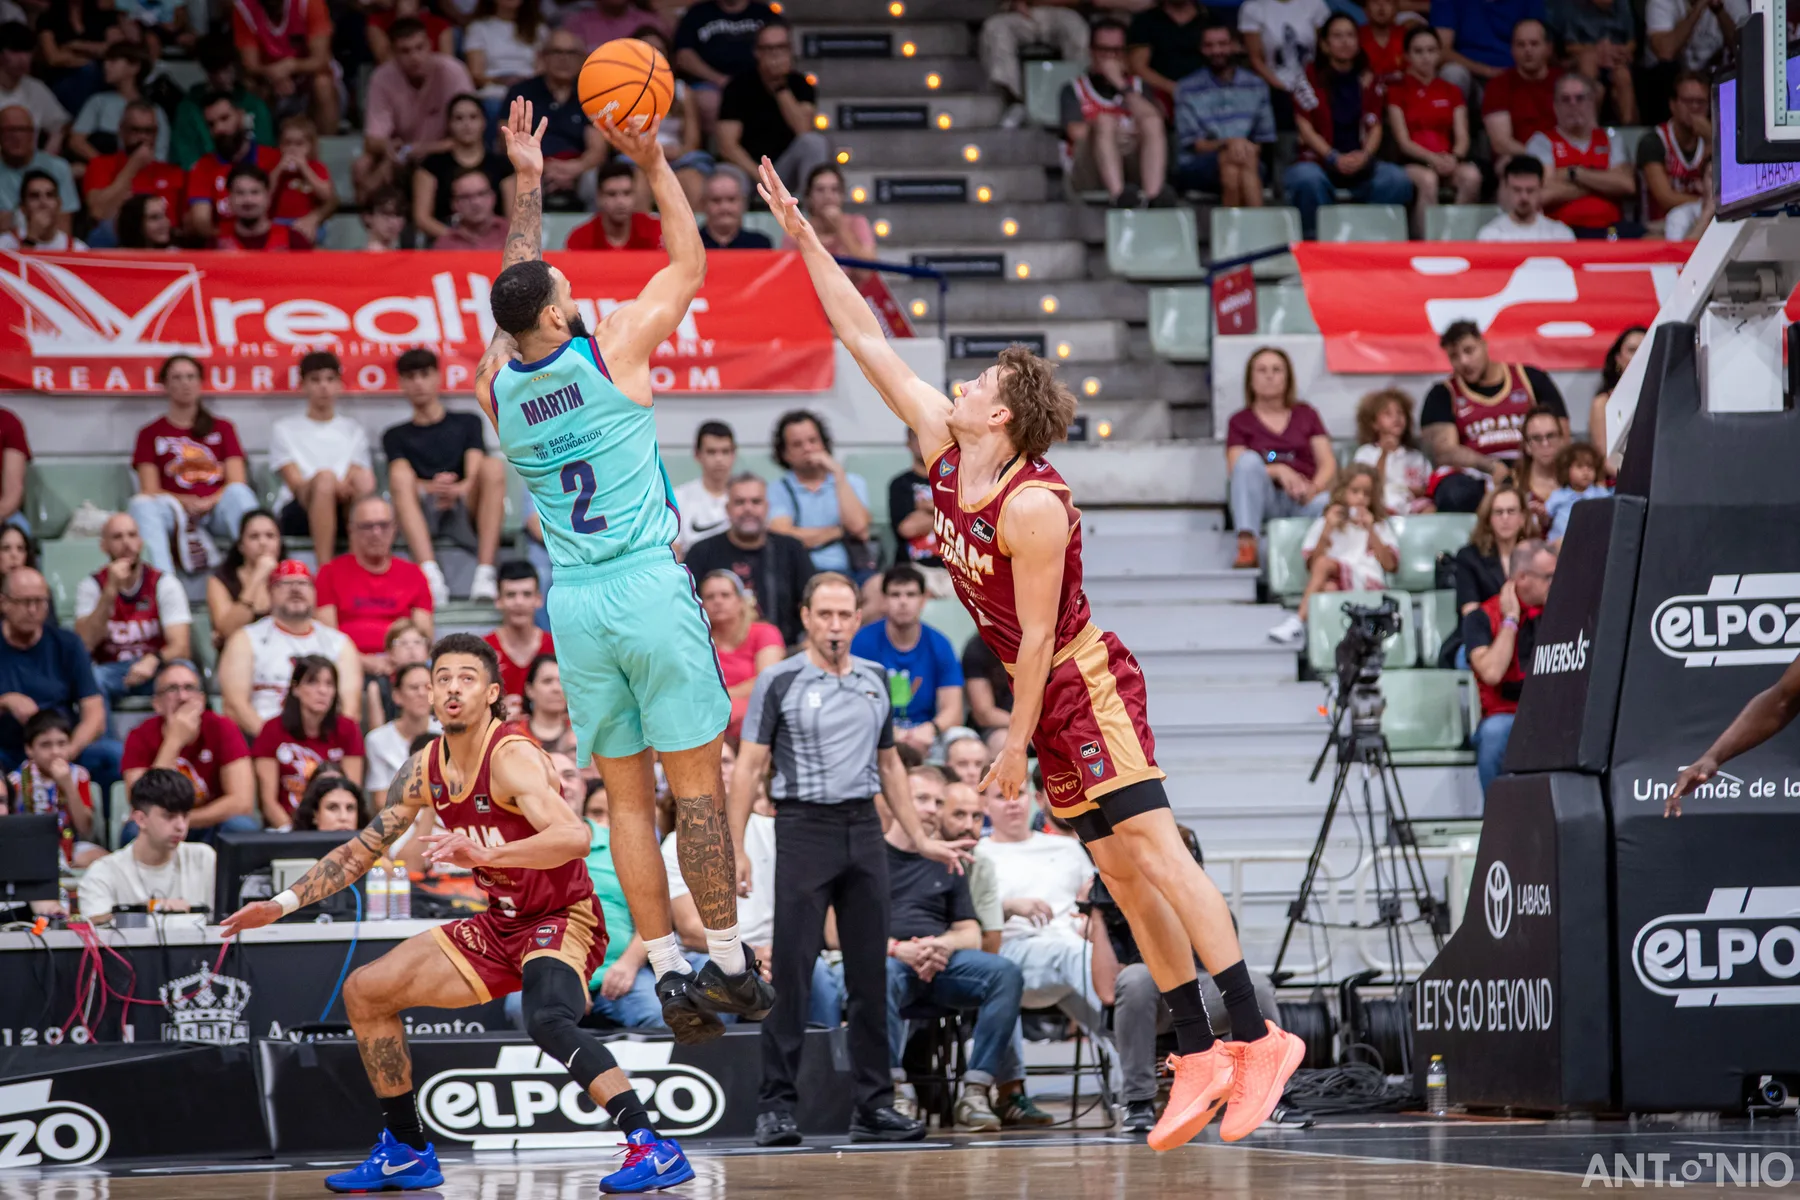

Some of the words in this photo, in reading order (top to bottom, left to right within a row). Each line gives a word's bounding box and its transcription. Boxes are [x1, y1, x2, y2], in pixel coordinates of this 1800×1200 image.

[291, 343, 459, 358] ATIFICAL
[520, 382, 585, 427] MARTIN
[548, 432, 575, 448] BARÇA
[552, 429, 602, 456] FOUNDATION
[560, 460, 608, 534] 2
[933, 505, 994, 576] UCAM
[1695, 778, 1741, 799] más
[1749, 777, 1776, 798] de
[1517, 884, 1551, 916] LABASA
[1416, 979, 1454, 1031] LET'S
[1457, 979, 1484, 1032] GO
[1487, 978, 1553, 1032] BEYOND
